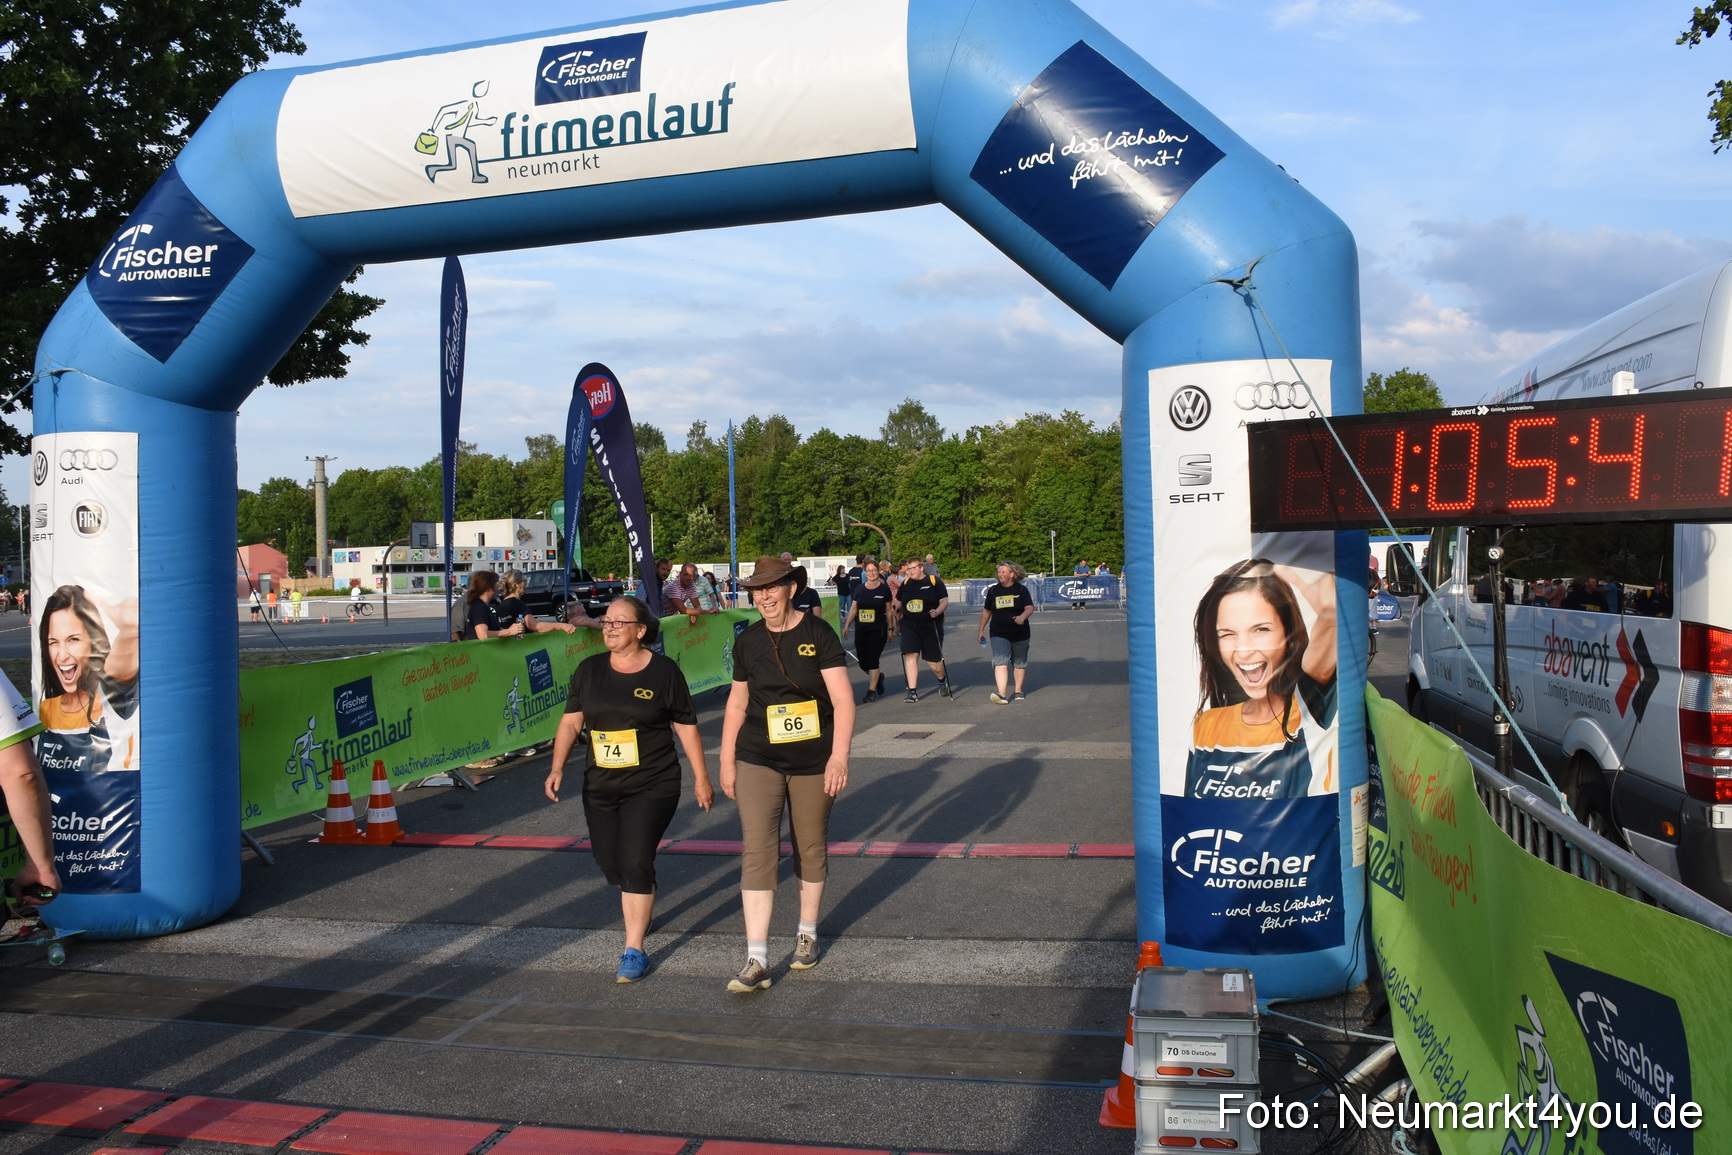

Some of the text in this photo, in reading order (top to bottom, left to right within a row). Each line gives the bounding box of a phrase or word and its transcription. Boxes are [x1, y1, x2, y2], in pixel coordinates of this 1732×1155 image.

[557, 55, 636, 79] Fischer
[564, 71, 628, 87] AUTOMOBILE
[500, 81, 736, 160] firmenlauf
[1018, 143, 1055, 171] und
[1061, 136, 1099, 156] das
[1103, 127, 1188, 150] Lächeln
[507, 153, 601, 180] neumarkt
[1070, 148, 1183, 189] fährt mit!
[112, 241, 218, 270] Fischer
[118, 266, 211, 282] AUTOMOBILE
[1451, 408, 1476, 417] abavent
[61, 477, 84, 485] Audi
[1169, 492, 1225, 504] SEAT
[79, 511, 101, 528] FIAT
[32, 532, 54, 541] SEAT
[1067, 586, 1105, 596] Fischer
[1376, 604, 1394, 612] scher
[1544, 618, 1610, 688] abavent
[342, 694, 369, 711] Fischer
[1569, 685, 1611, 715] innovations
[784, 716, 804, 732] 66
[322, 707, 413, 770] firmenlauf
[604, 744, 622, 758] 74
[41, 754, 86, 772] Fischer
[1203, 776, 1281, 800] Fischer
[51, 811, 114, 832] scher
[52, 832, 105, 842] TOMOBILE
[66, 849, 83, 861] das
[84, 848, 129, 861] Lächeln
[1193, 849, 1316, 876] Fischer
[69, 860, 125, 876] fährt mit!
[1204, 876, 1308, 890] AUTOMOBILE
[1225, 903, 1251, 917] und
[1255, 899, 1281, 913] das
[1283, 895, 1334, 912] Lächeln
[1260, 907, 1332, 934] fährt mit!
[1166, 1047, 1179, 1056] 70
[1597, 1020, 1675, 1099] Fischer
[1615, 1066, 1672, 1123] AUTOMOBLE
[1167, 1116, 1179, 1124] 86
